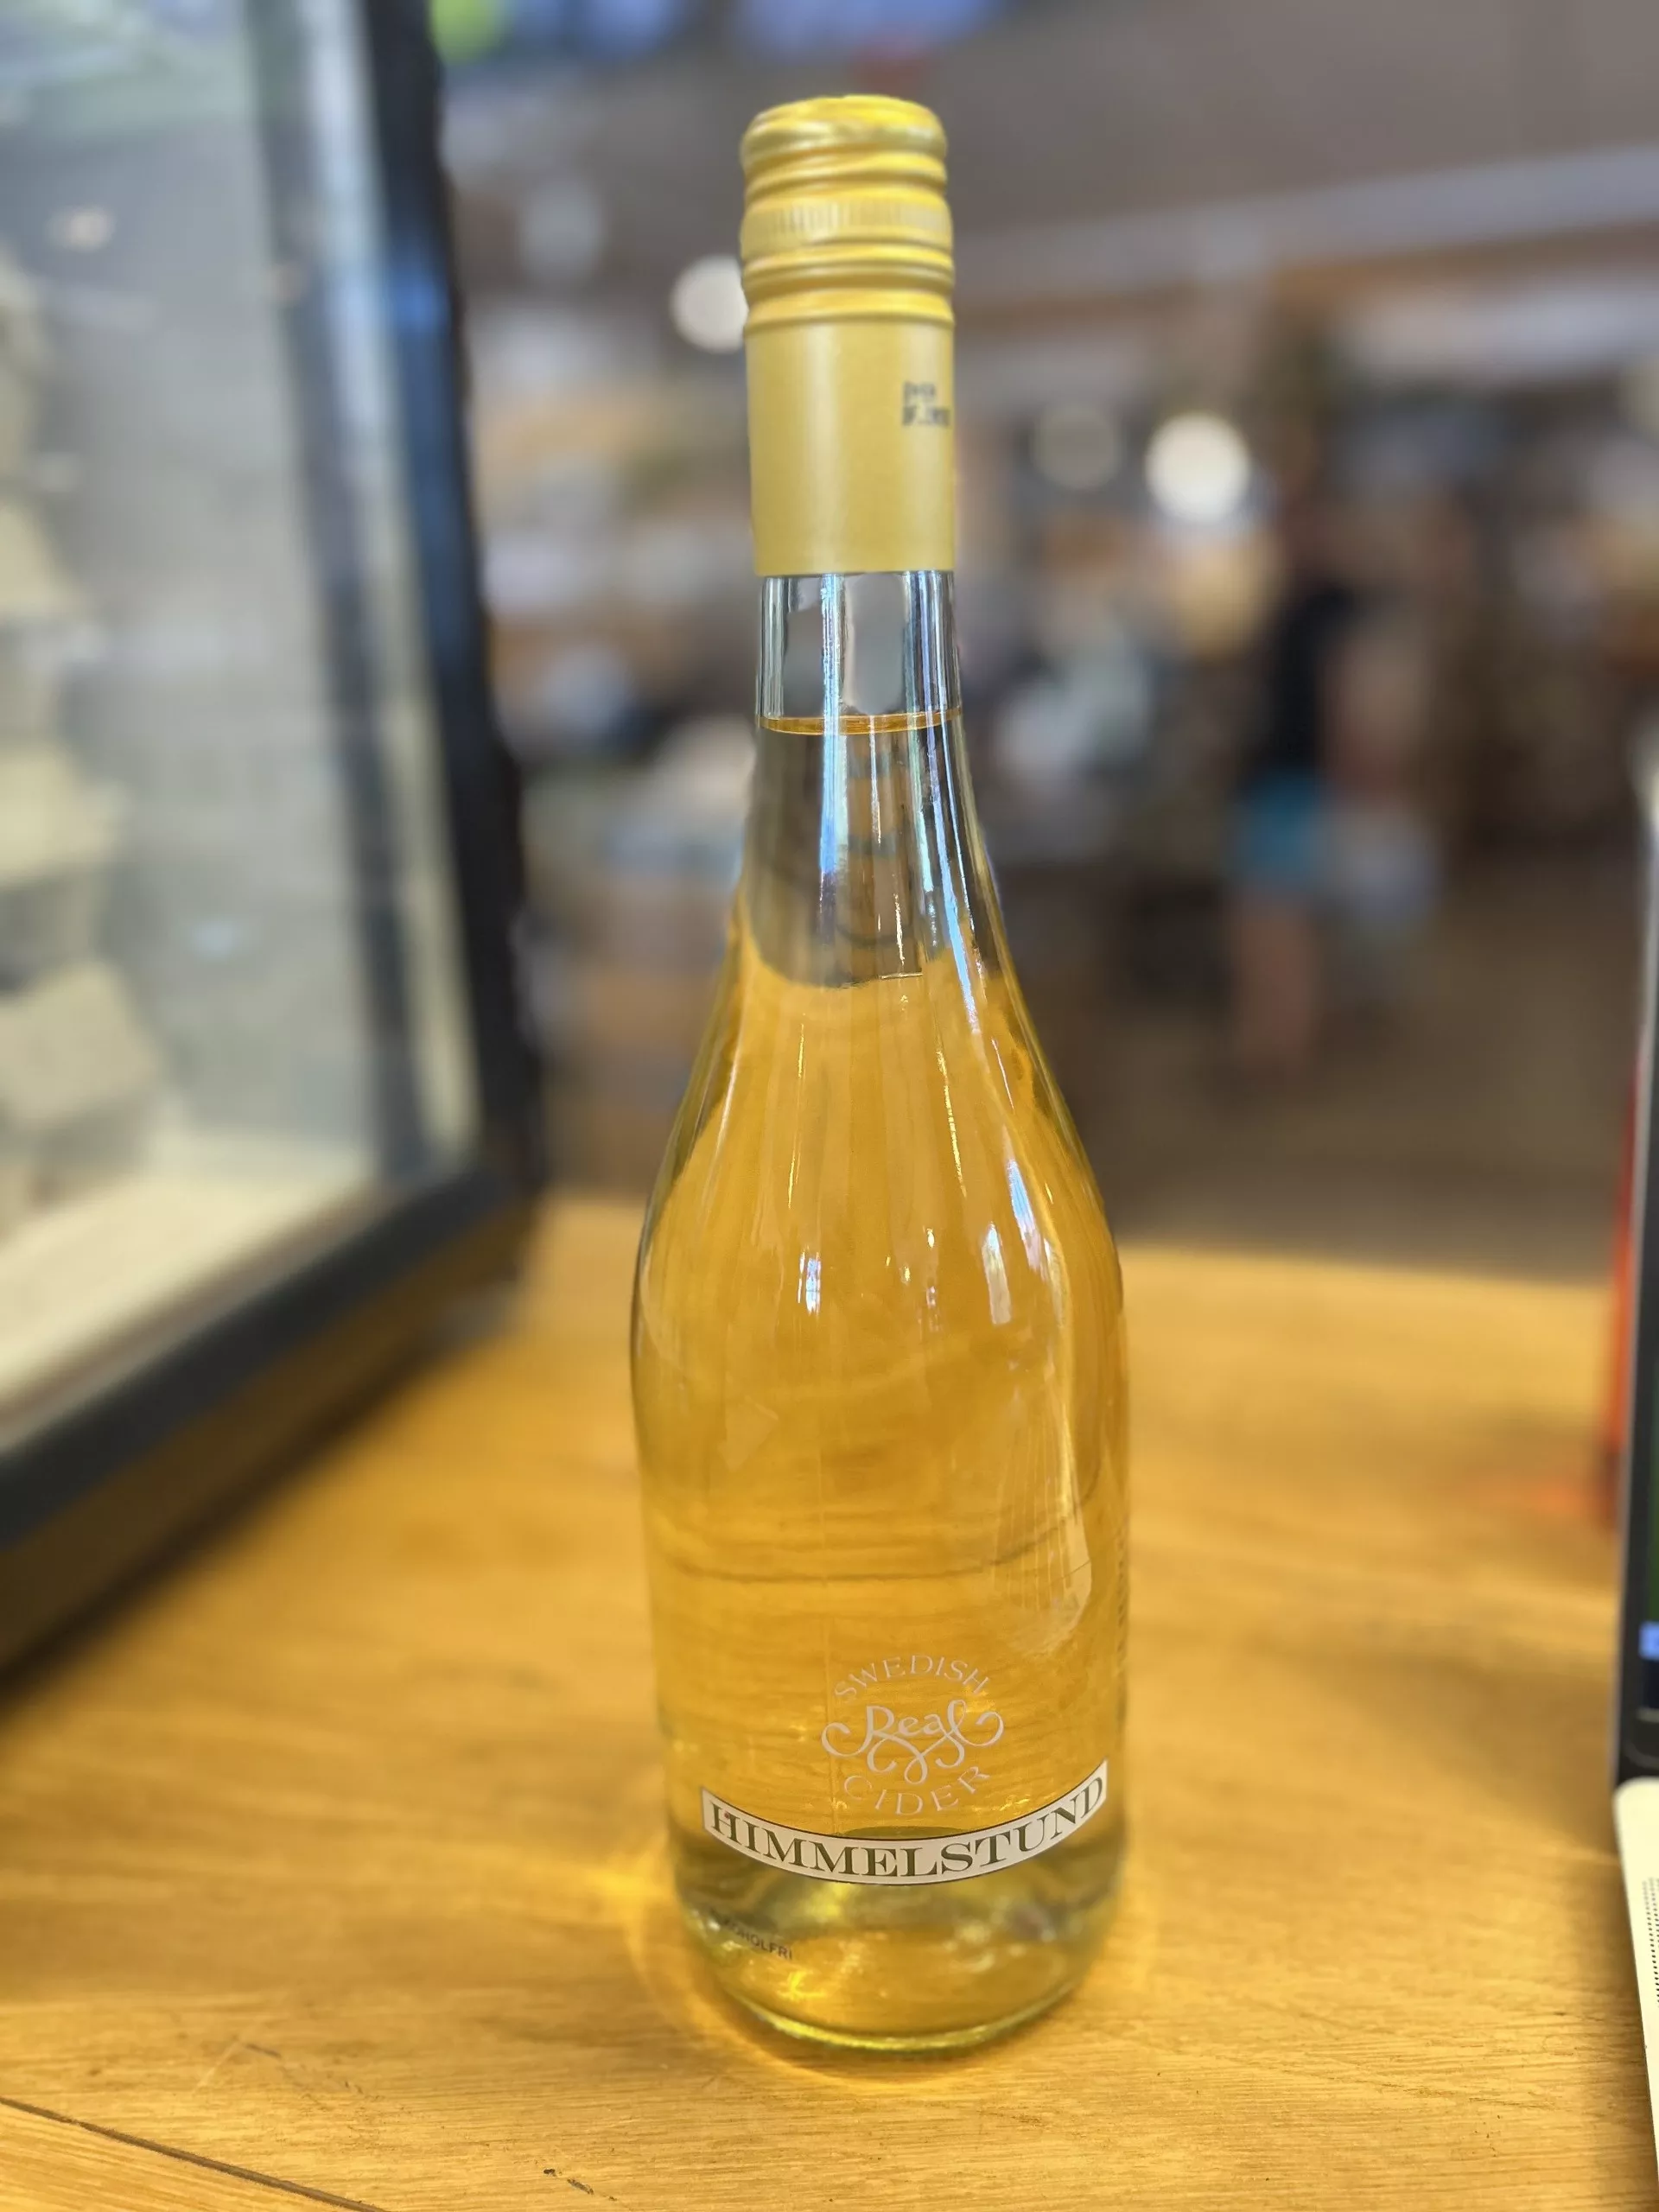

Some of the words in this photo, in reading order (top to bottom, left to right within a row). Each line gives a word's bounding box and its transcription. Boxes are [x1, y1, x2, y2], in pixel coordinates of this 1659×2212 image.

[834, 1654, 989, 1702] SWEDISH
[821, 1699, 1004, 1785] Real
[843, 1765, 990, 1815] CIDER
[709, 1776, 1104, 1877] HIMMELSTUND
